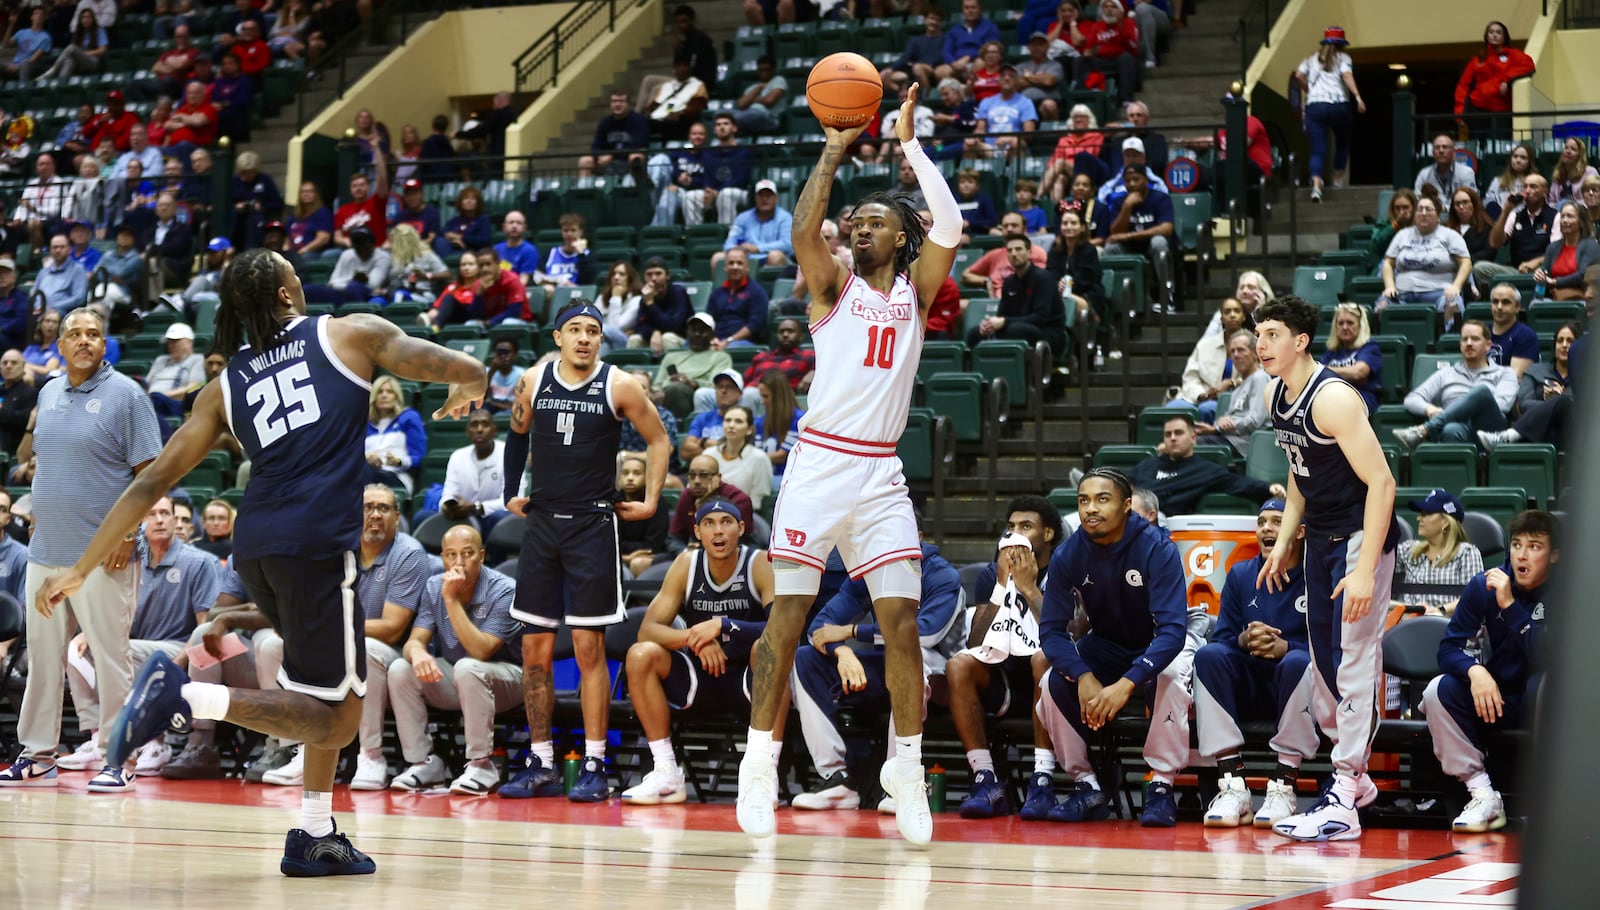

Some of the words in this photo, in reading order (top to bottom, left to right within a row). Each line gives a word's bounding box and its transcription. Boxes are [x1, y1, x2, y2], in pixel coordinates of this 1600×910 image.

[1173, 170, 1190, 185] 114
[238, 369, 252, 384] J.
[248, 340, 306, 374] WILLIAMS
[863, 325, 896, 369] 10
[246, 361, 321, 449] 25
[536, 398, 604, 415] GEORGETOWN
[556, 412, 576, 446] 4
[1188, 546, 1214, 577] G
[1125, 569, 1144, 587] G
[692, 599, 750, 613] GEORGETOWN
[991, 618, 1041, 649] GATORA
